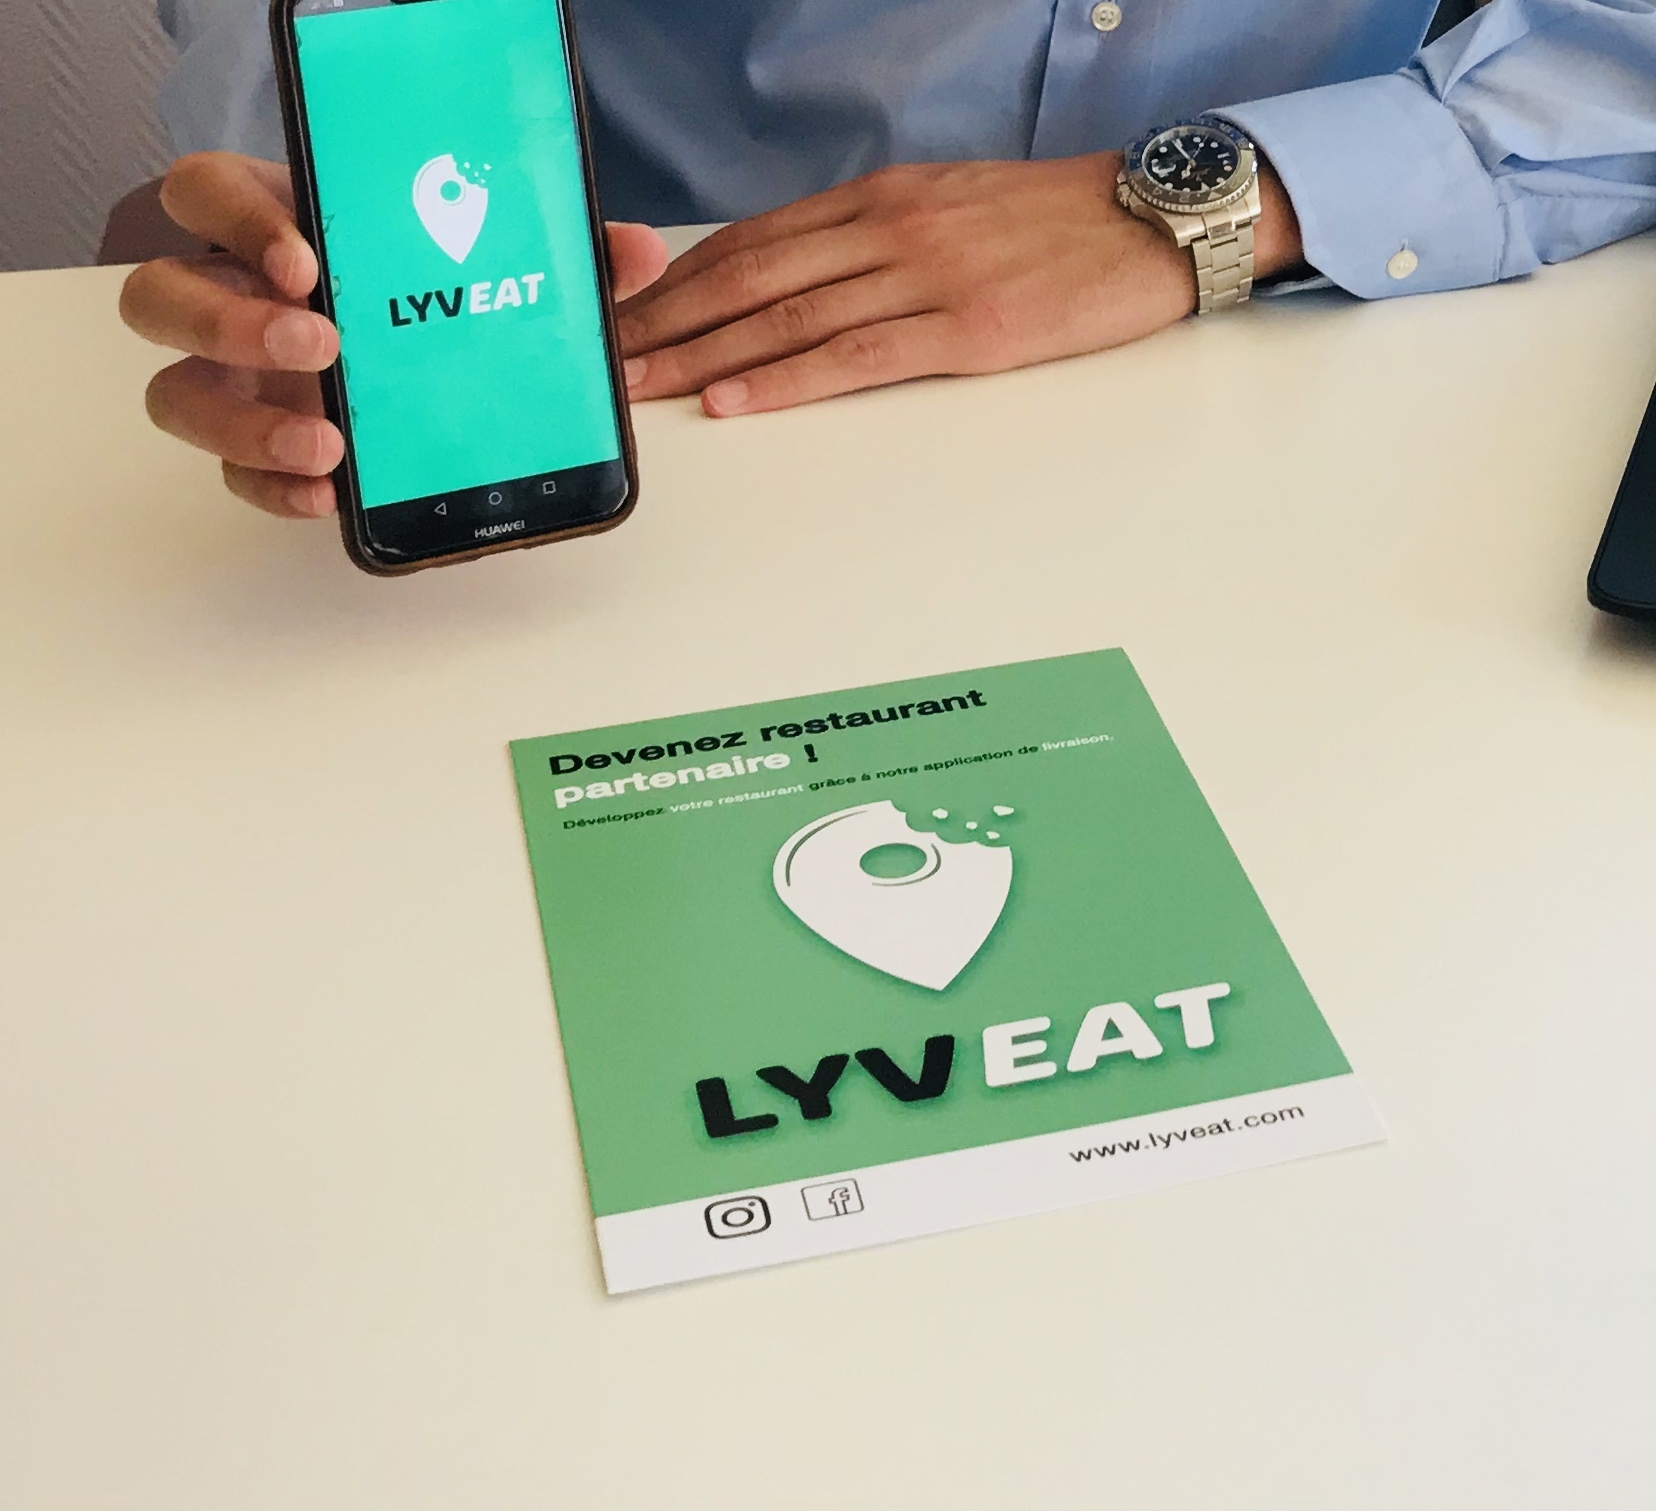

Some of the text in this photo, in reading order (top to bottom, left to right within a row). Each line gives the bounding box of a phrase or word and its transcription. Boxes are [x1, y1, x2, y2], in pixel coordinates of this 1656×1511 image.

[389, 272, 545, 327] LYVEAT
[474, 519, 526, 538] HUAWEI
[548, 689, 988, 775] Devenez restaurant
[554, 753, 791, 809] partenaire
[563, 806, 665, 830] Développez
[669, 798, 714, 813] votre
[718, 783, 804, 805] restaurant
[808, 775, 857, 792] grâce
[861, 772, 871, 782] à
[876, 764, 919, 780] notre
[924, 749, 1014, 774] application
[1018, 744, 1039, 755] de
[695, 981, 1231, 1139] LYVEAT
[1069, 1105, 1305, 1163] www.lyveat.com
